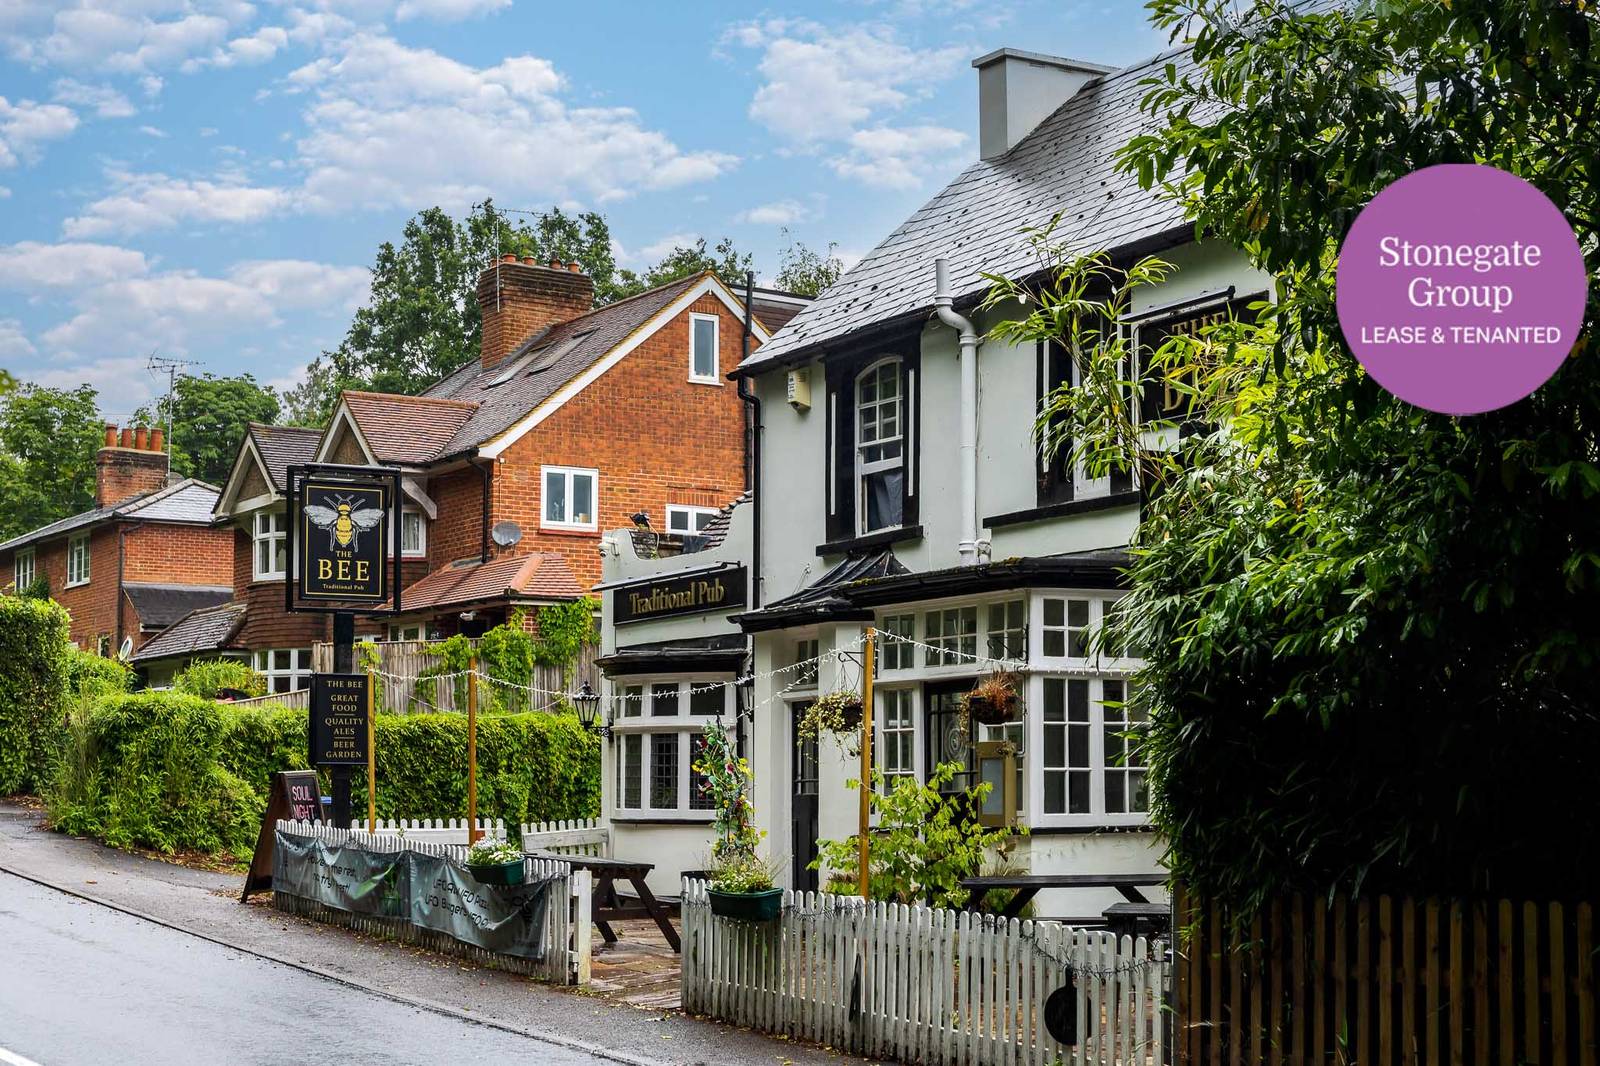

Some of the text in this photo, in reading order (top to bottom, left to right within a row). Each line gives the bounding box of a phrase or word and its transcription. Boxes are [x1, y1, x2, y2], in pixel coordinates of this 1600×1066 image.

[335, 550, 353, 558] THE
[317, 558, 370, 581] BEE
[628, 577, 725, 615] Traditional Pub
[327, 680, 363, 688] THE BEE
[330, 694, 359, 702] GREAT
[332, 704, 357, 712] FOOD
[324, 717, 364, 727] QUALITY
[291, 785, 313, 801] SOUL
